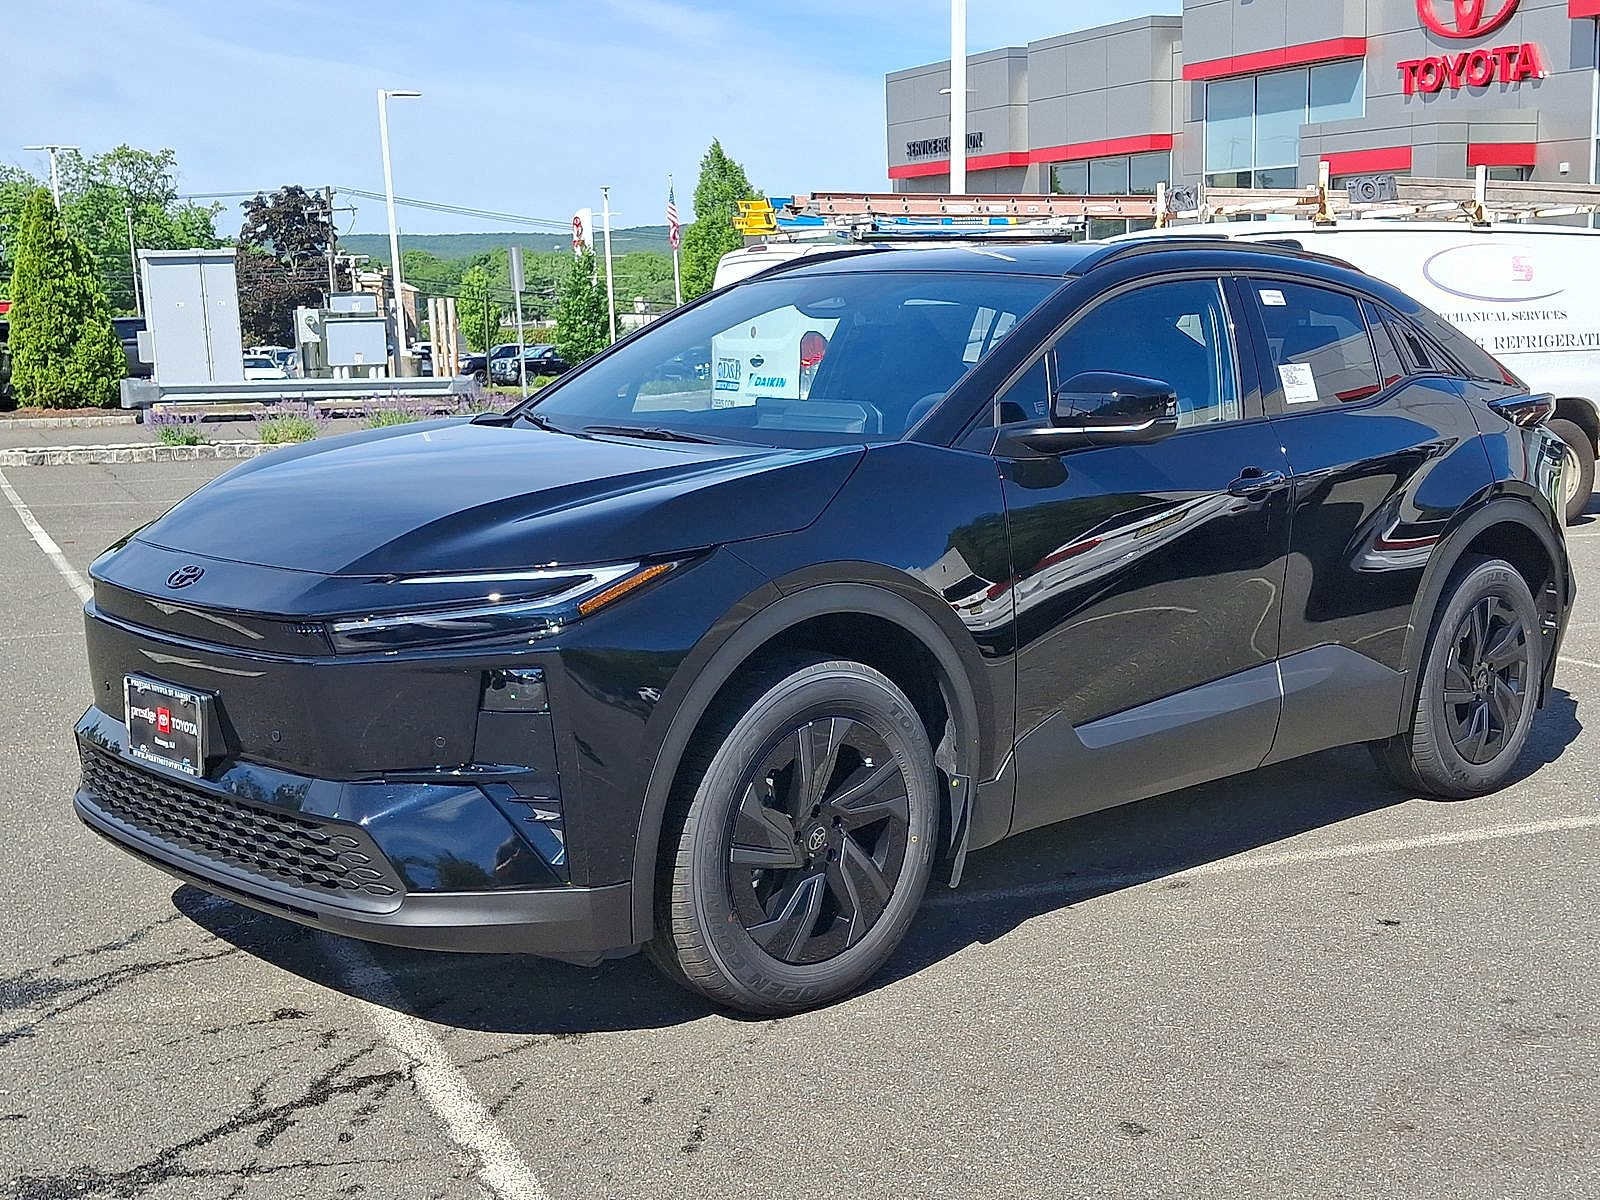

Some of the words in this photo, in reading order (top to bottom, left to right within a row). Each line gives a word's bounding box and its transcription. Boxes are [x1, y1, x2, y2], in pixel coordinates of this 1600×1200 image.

[1397, 43, 1543, 96] TOYOTA
[939, 132, 983, 153] RECION
[1440, 311, 1509, 322] ECHANICAL
[1511, 310, 1568, 321] SERVICES
[754, 376, 787, 388] DAIKIN
[130, 706, 157, 724] prestige
[171, 717, 198, 736] TOYOTA
